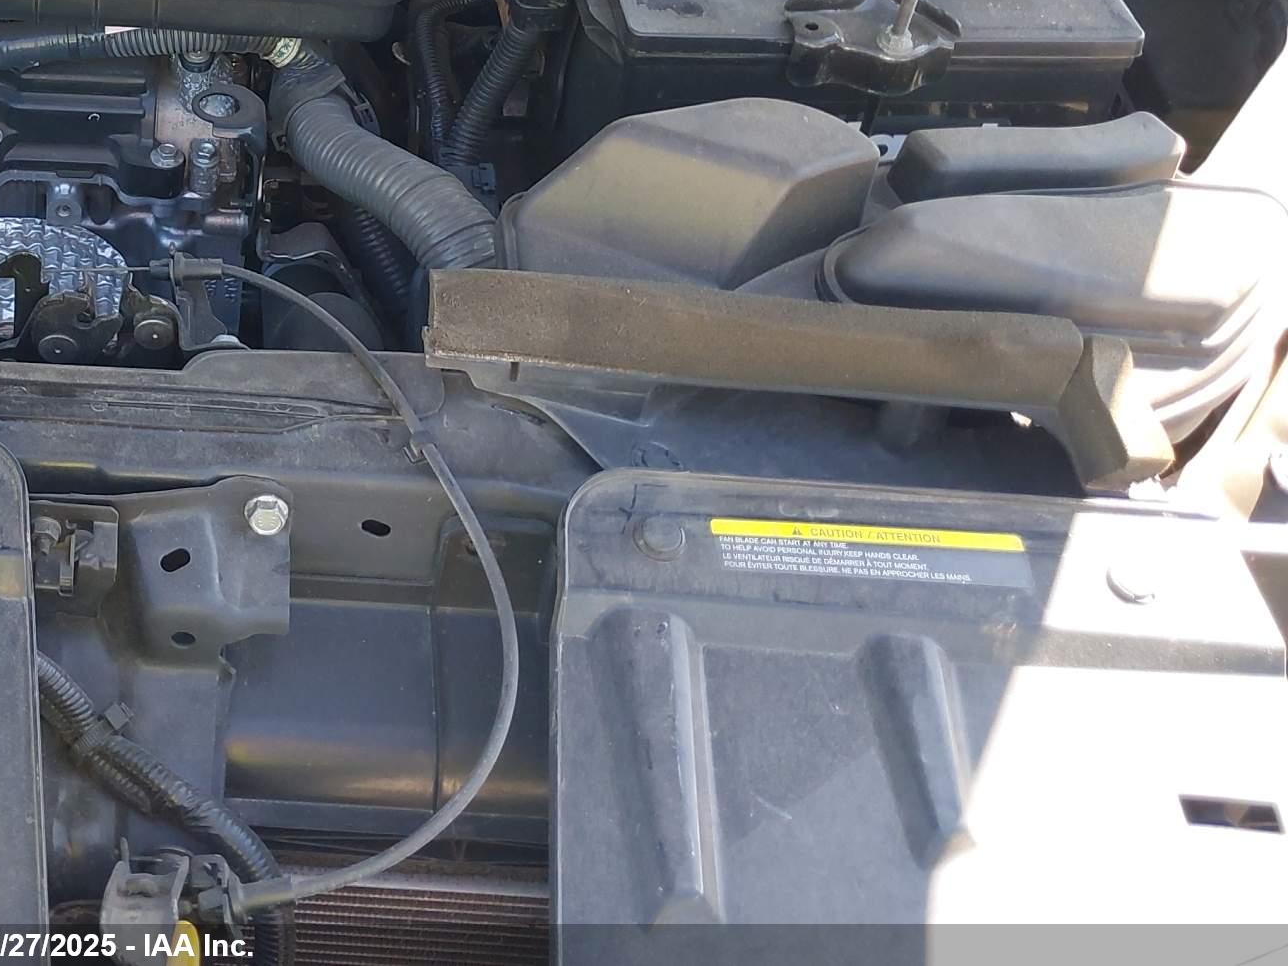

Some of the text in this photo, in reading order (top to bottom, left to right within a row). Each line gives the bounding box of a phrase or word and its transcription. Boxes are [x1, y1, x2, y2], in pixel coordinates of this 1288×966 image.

[809, 528, 862, 539] CAUTION
[875, 531, 942, 544] ATTENTION
[733, 553, 781, 562] VENTILATEUR
[782, 556, 810, 564] RISQUE
[753, 545, 775, 553] AVOID
[777, 546, 817, 555] PERSONAL
[865, 552, 891, 560] HANDS
[774, 563, 798, 571] TOUTE
[882, 570, 929, 579] APPROCHER
